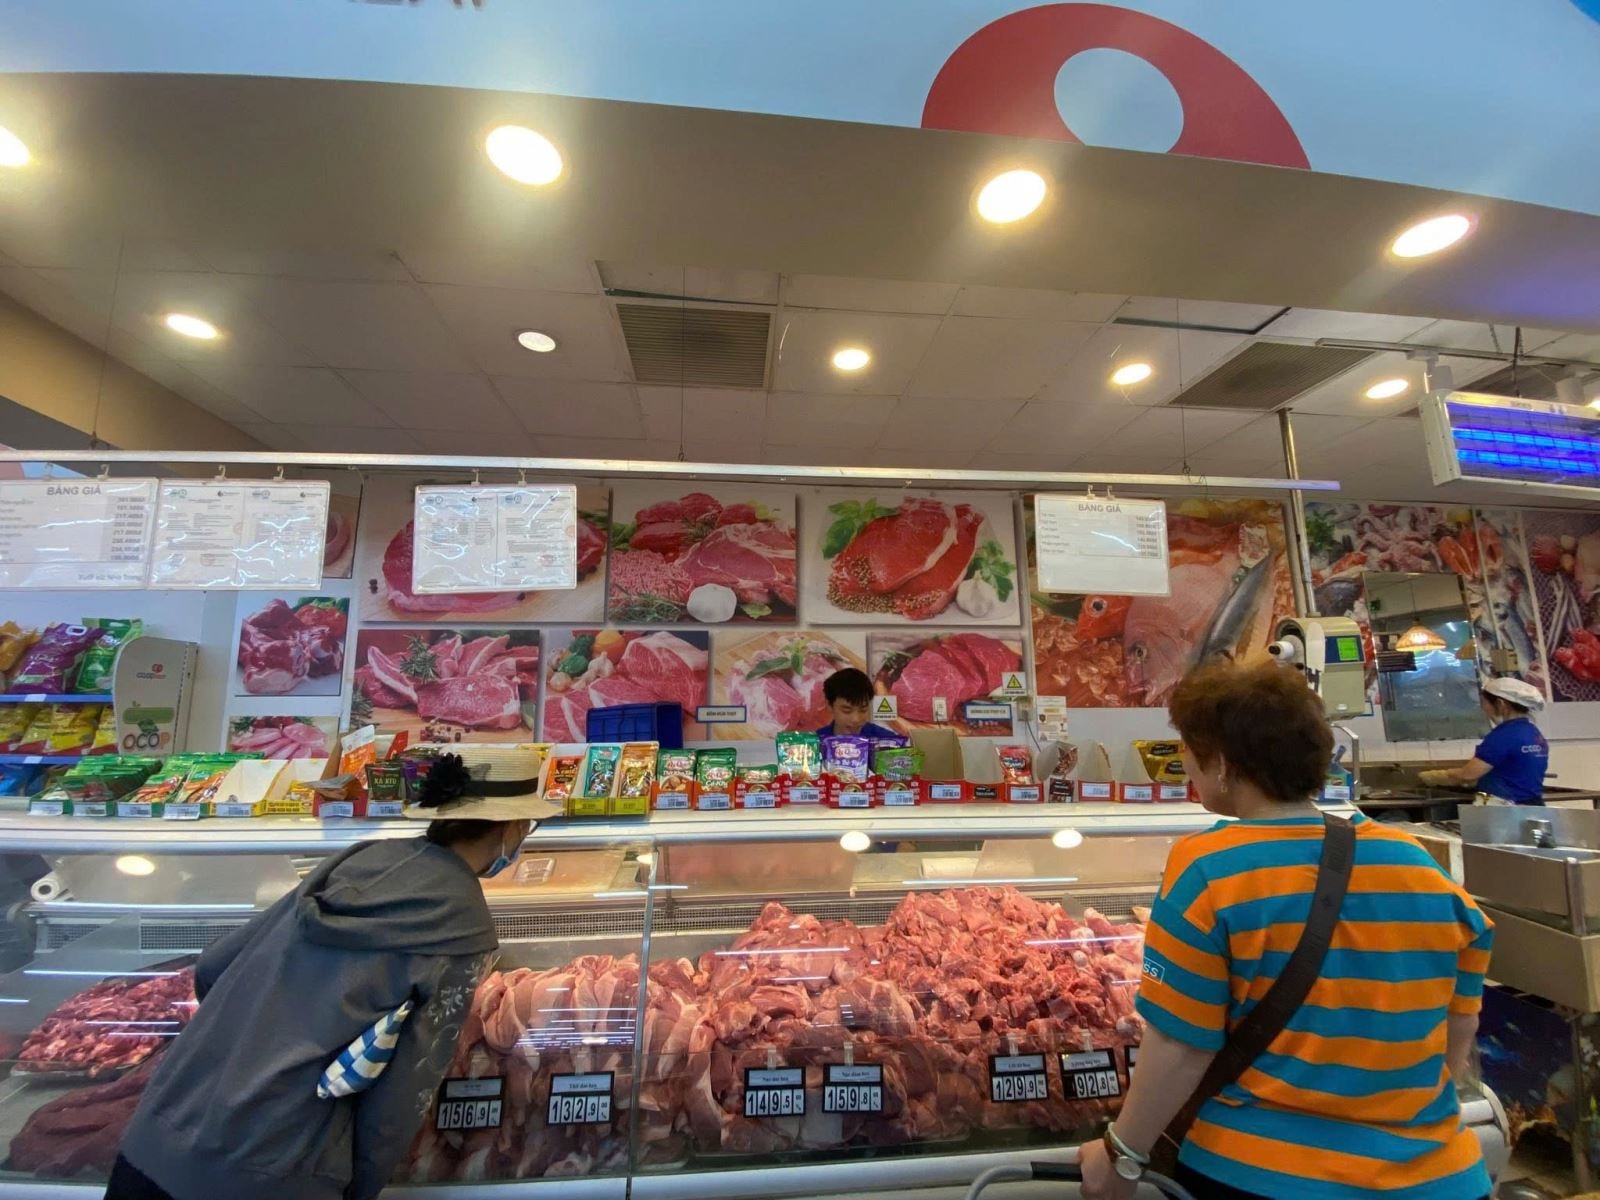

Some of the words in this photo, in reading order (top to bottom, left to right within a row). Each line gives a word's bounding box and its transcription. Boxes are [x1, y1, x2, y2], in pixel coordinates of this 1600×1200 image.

[47, 485, 79, 496] BẢNG
[82, 484, 101, 496] GIÁ
[1105, 503, 1122, 513] GIÁ
[123, 732, 171, 750] OCOP
